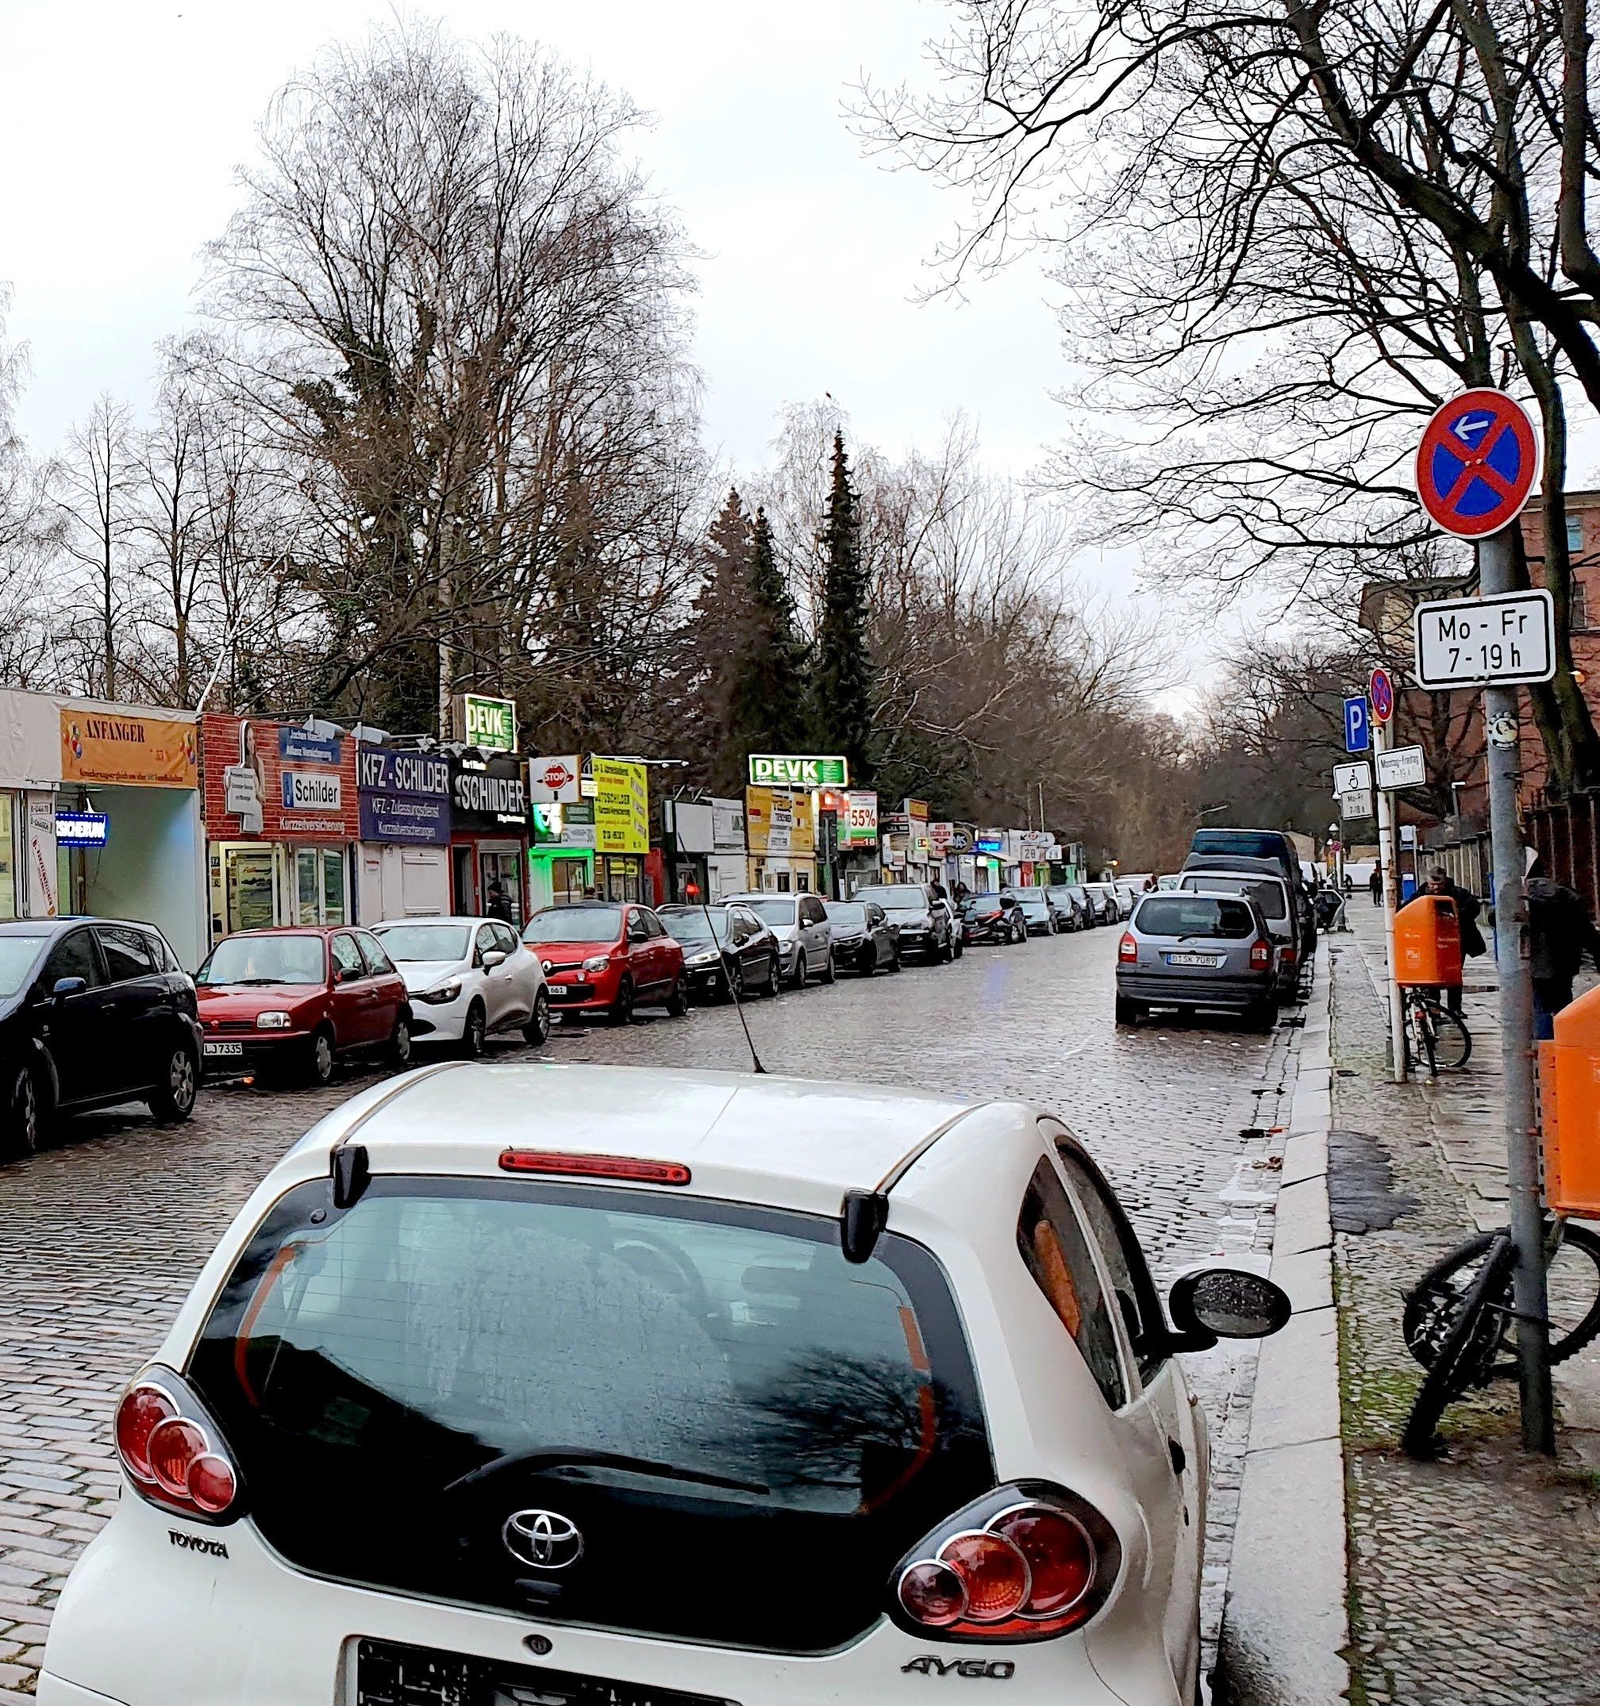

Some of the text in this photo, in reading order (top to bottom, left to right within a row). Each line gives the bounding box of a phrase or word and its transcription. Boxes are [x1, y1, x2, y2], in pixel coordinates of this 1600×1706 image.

[1438, 615, 1471, 643] Mo
[1501, 609, 1528, 638] Fr
[1510, 641, 1521, 669] h
[467, 702, 505, 737] DEVK
[1350, 704, 1363, 745] P
[362, 752, 387, 788] KFZ
[394, 756, 450, 794] SCHILDER
[545, 772, 565, 781] STOP
[755, 759, 819, 778] DEVK
[295, 778, 338, 803] Schilder
[850, 809, 876, 827] 55%
[218, 1044, 242, 1054] 7335
[167, 1528, 230, 1560] TOYOTA
[900, 1654, 1016, 1680] AYGO
